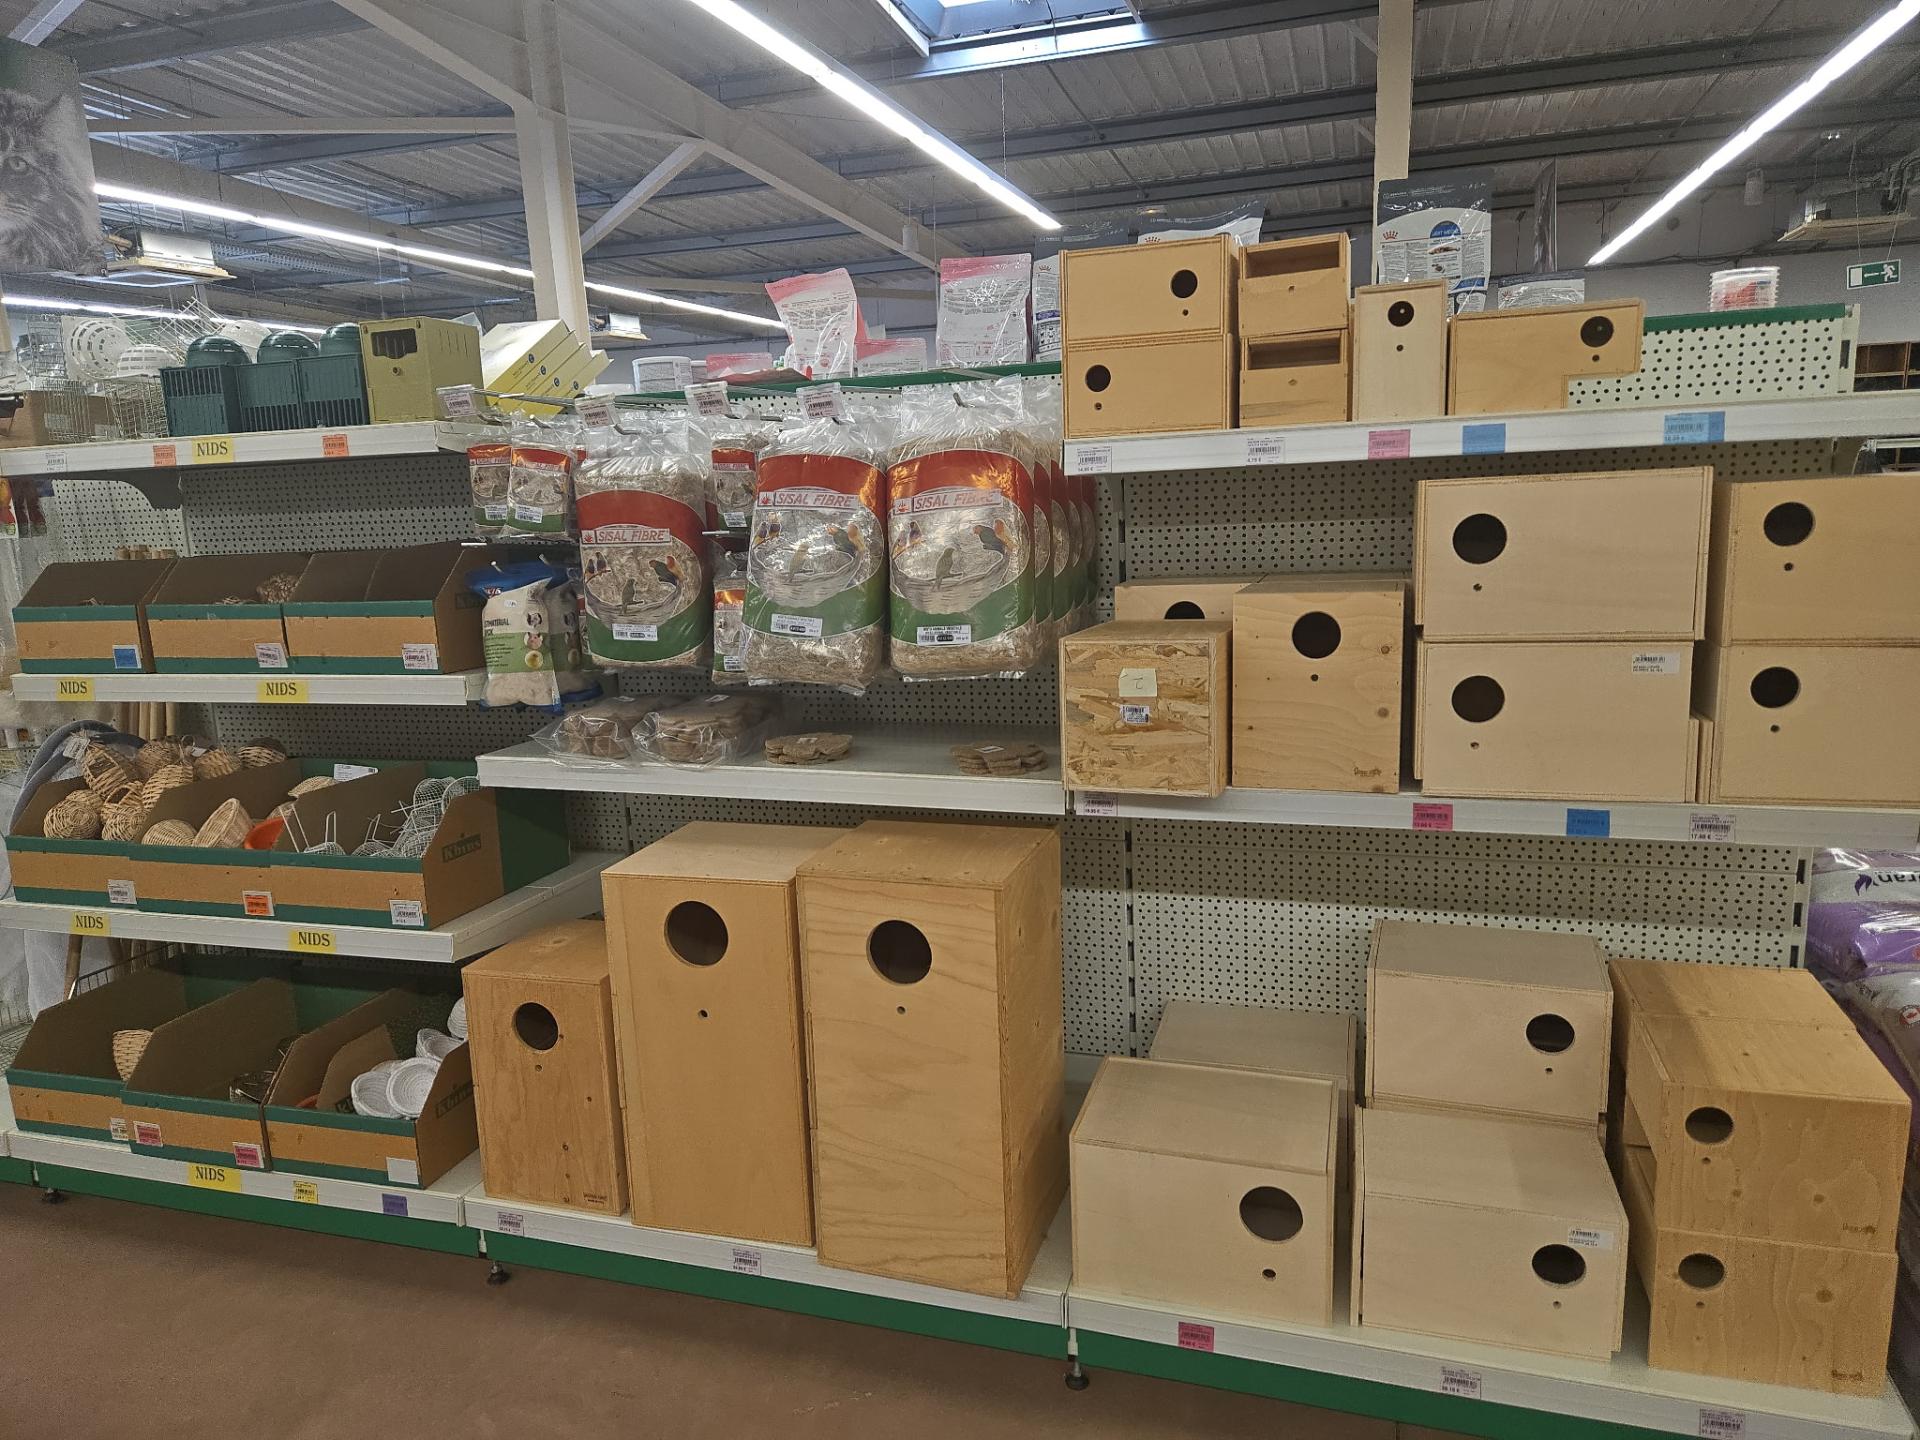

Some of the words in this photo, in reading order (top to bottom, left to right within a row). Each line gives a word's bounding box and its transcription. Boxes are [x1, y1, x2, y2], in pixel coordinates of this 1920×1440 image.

[196, 442, 228, 457] NIDS
[777, 493, 809, 504] SISAL
[813, 494, 854, 507] FIBRE
[915, 494, 949, 510] SISAL
[598, 530, 627, 542] SISAL
[631, 530, 665, 541] FIBRE
[60, 681, 87, 695] NIDS
[266, 682, 297, 697] NIDS
[75, 915, 104, 930] NIDS
[298, 932, 331, 947] NIDS
[195, 1166, 225, 1182] NIDS
